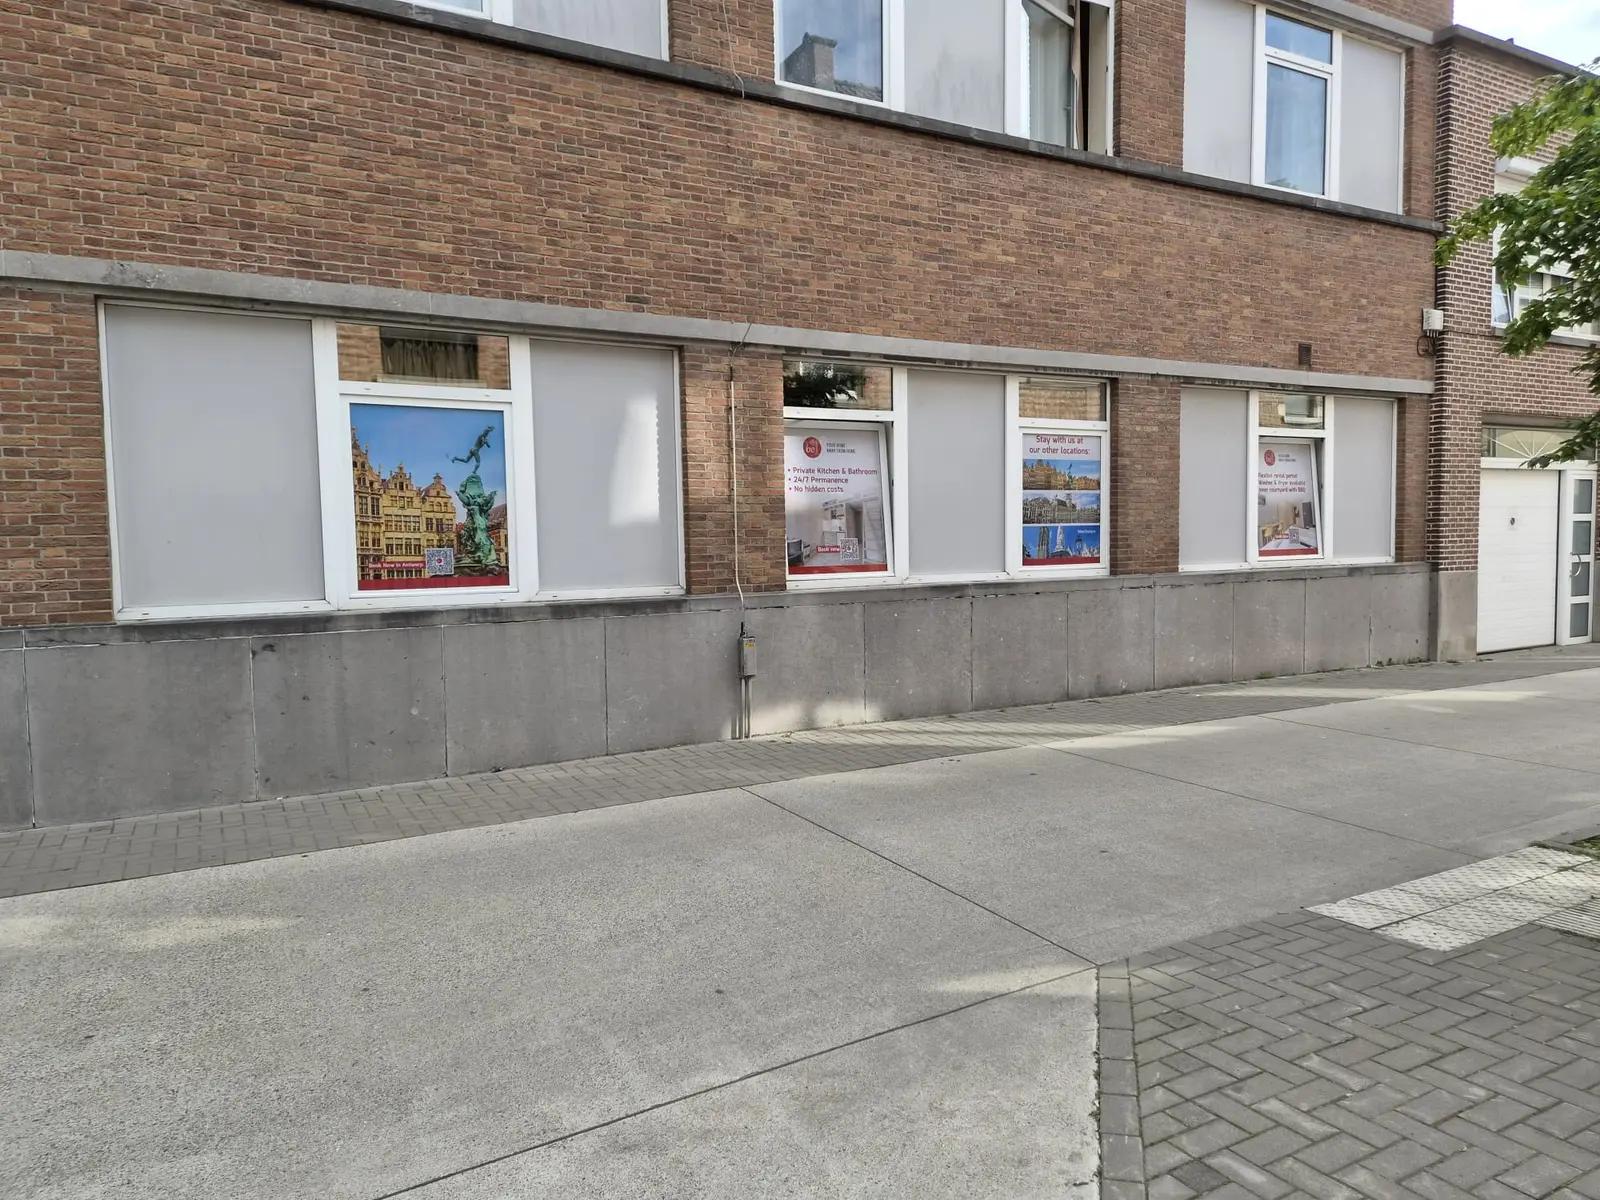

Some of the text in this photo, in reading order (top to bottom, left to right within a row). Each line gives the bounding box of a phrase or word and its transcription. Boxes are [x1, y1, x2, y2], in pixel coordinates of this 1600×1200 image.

[1036, 434, 1051, 445] Stay
[1052, 435, 1067, 444] with
[1041, 446, 1059, 454] other
[792, 466, 878, 475] Private Kitchen & Bathroom
[793, 475, 849, 484] 24/7 Permanence
[804, 485, 826, 493] hidden
